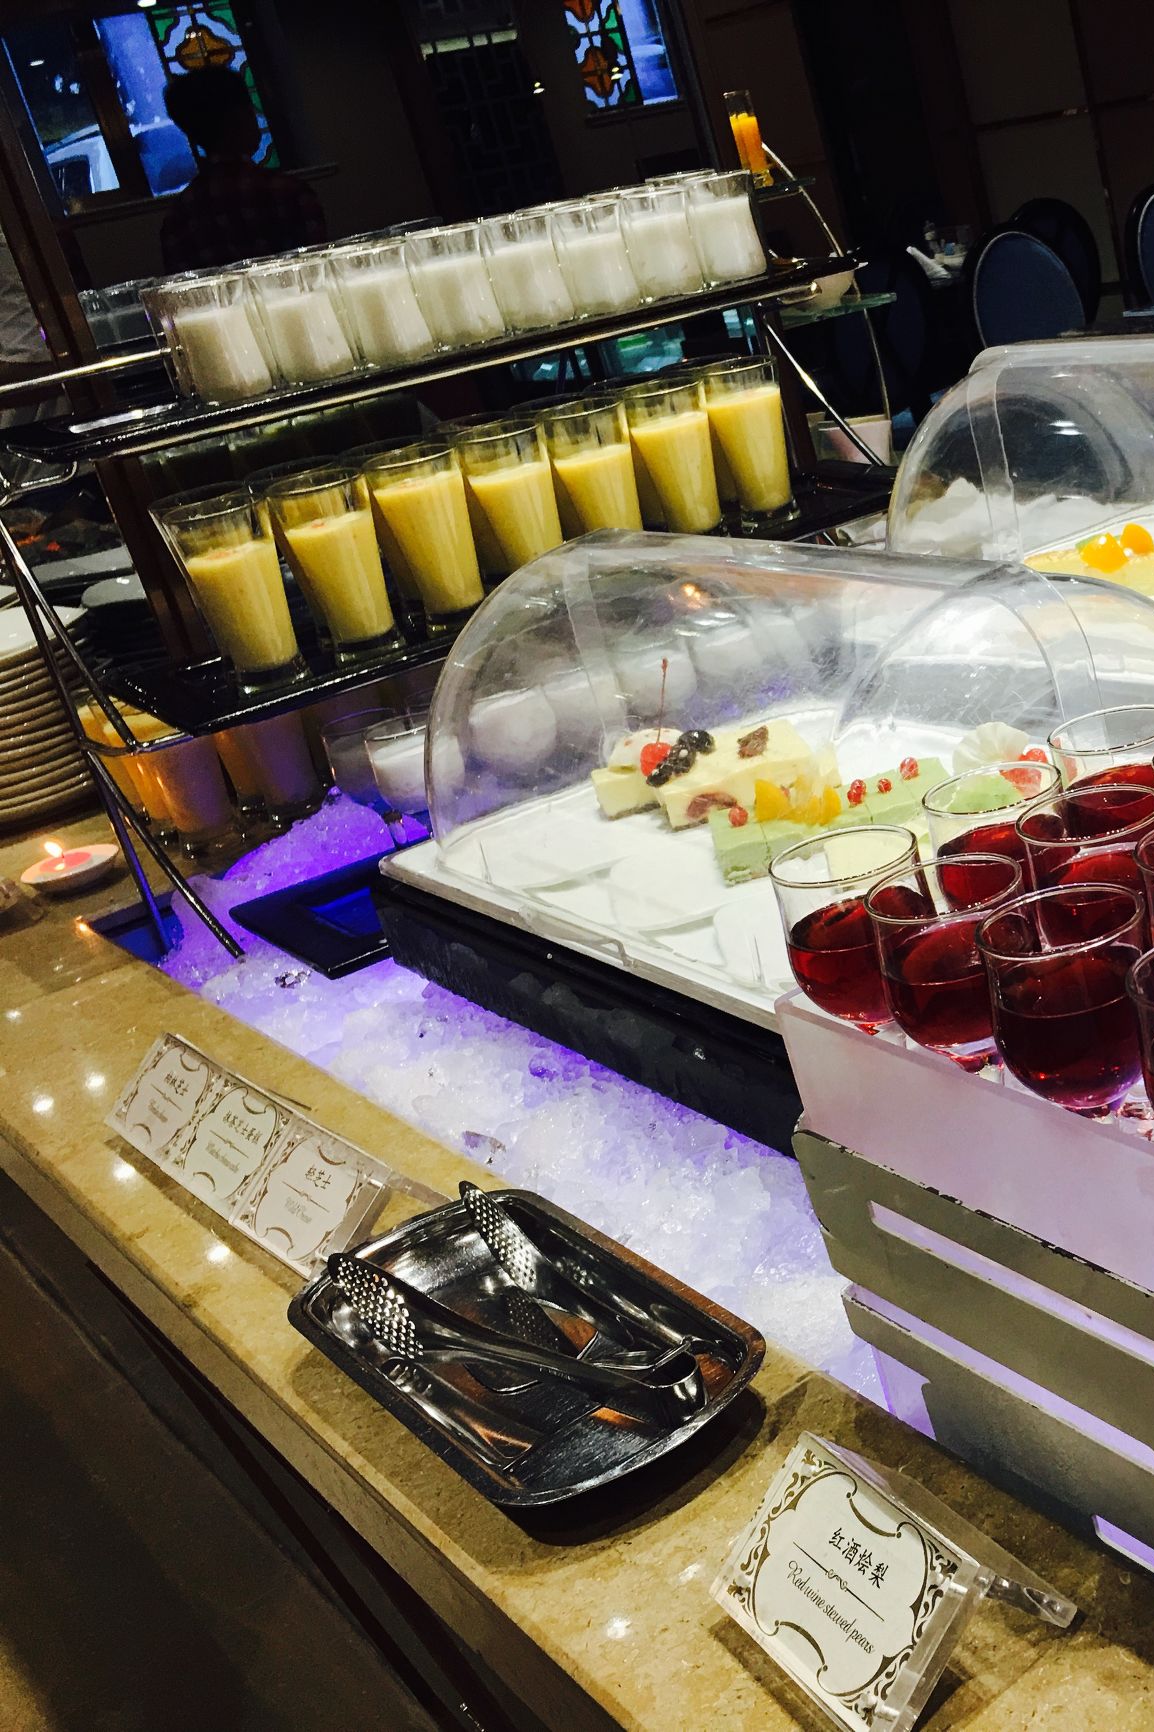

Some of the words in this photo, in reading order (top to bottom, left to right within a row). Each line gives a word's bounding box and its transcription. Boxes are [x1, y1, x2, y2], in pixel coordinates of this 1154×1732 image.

[828, 1527, 888, 1589] 红酒烩梨
[787, 1560, 811, 1591] Red
[803, 1587, 825, 1609] wine
[822, 1604, 856, 1634] stewed
[845, 1628, 875, 1654] pears
